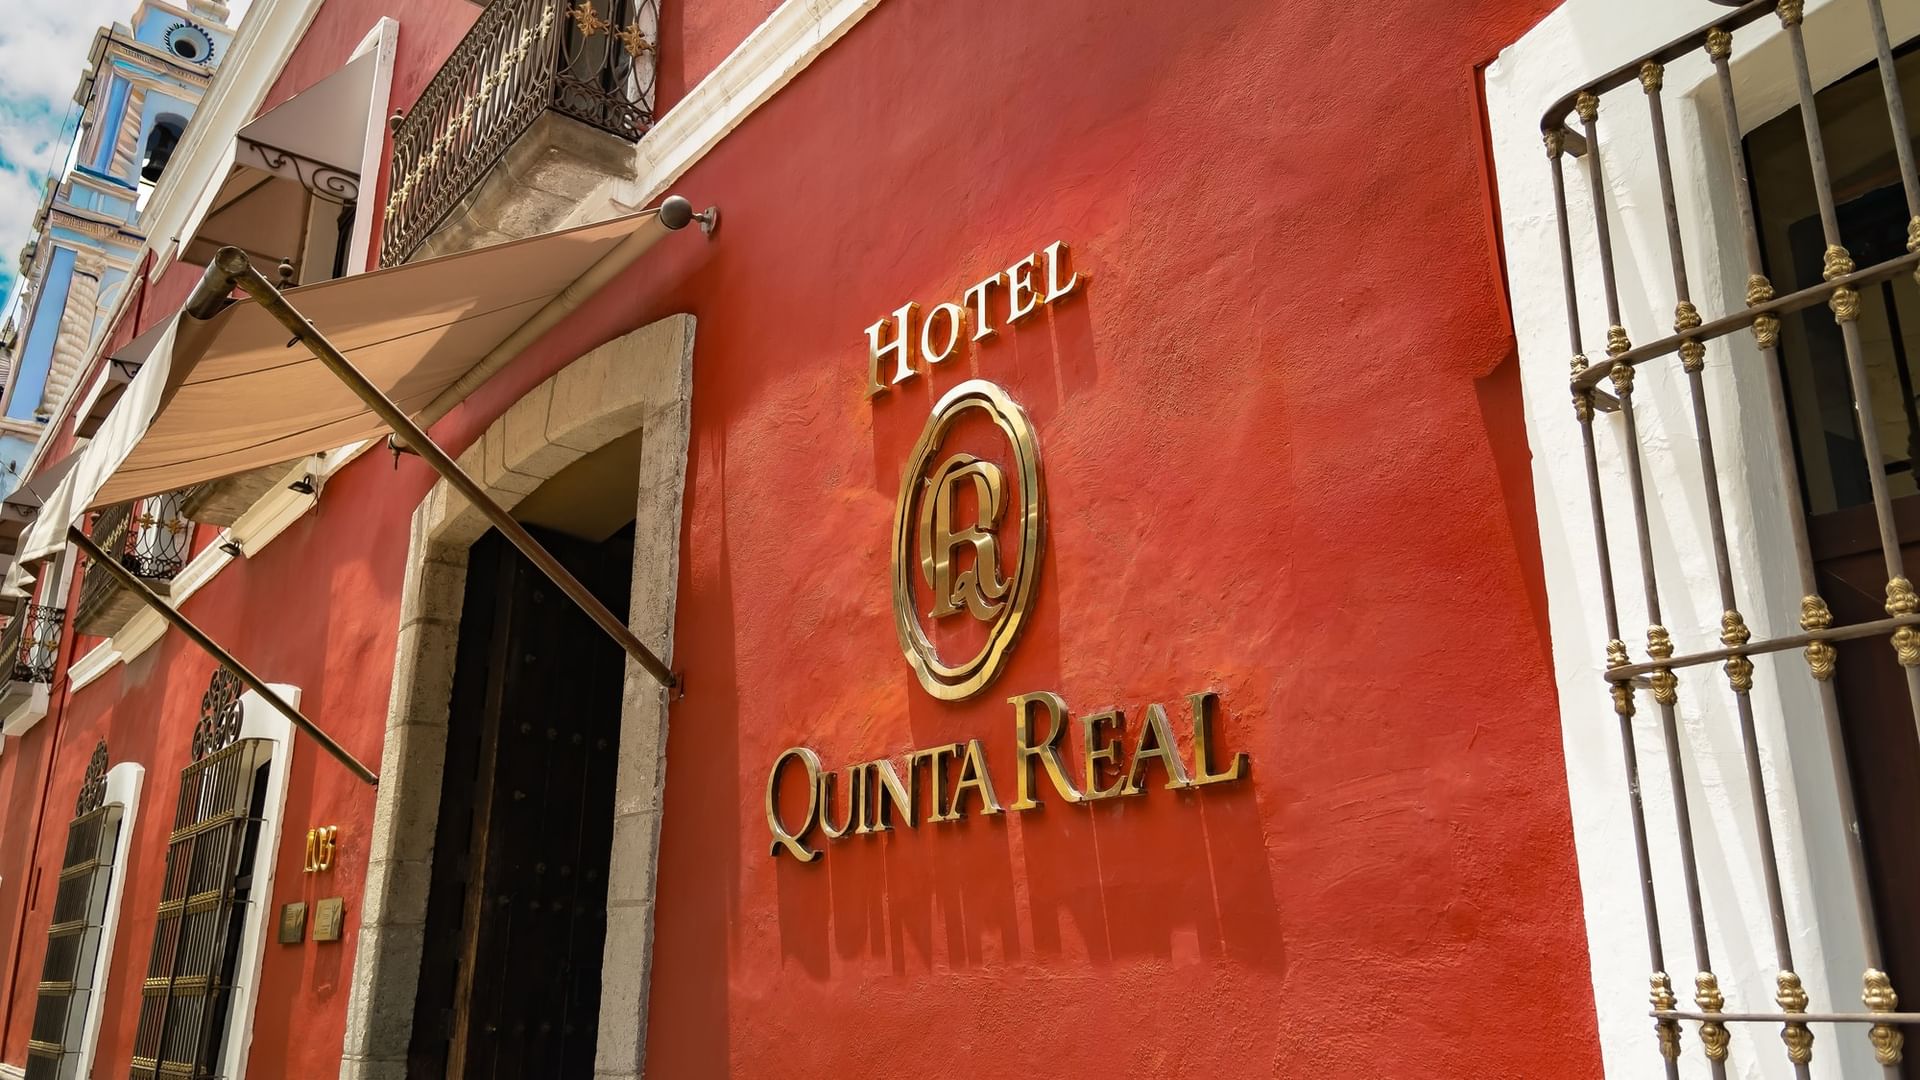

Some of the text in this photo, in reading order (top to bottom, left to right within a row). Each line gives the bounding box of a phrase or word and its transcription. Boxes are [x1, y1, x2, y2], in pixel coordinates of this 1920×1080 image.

[864, 240, 1083, 397] HOTEL
[766, 691, 1246, 862] QUINTA REAL
